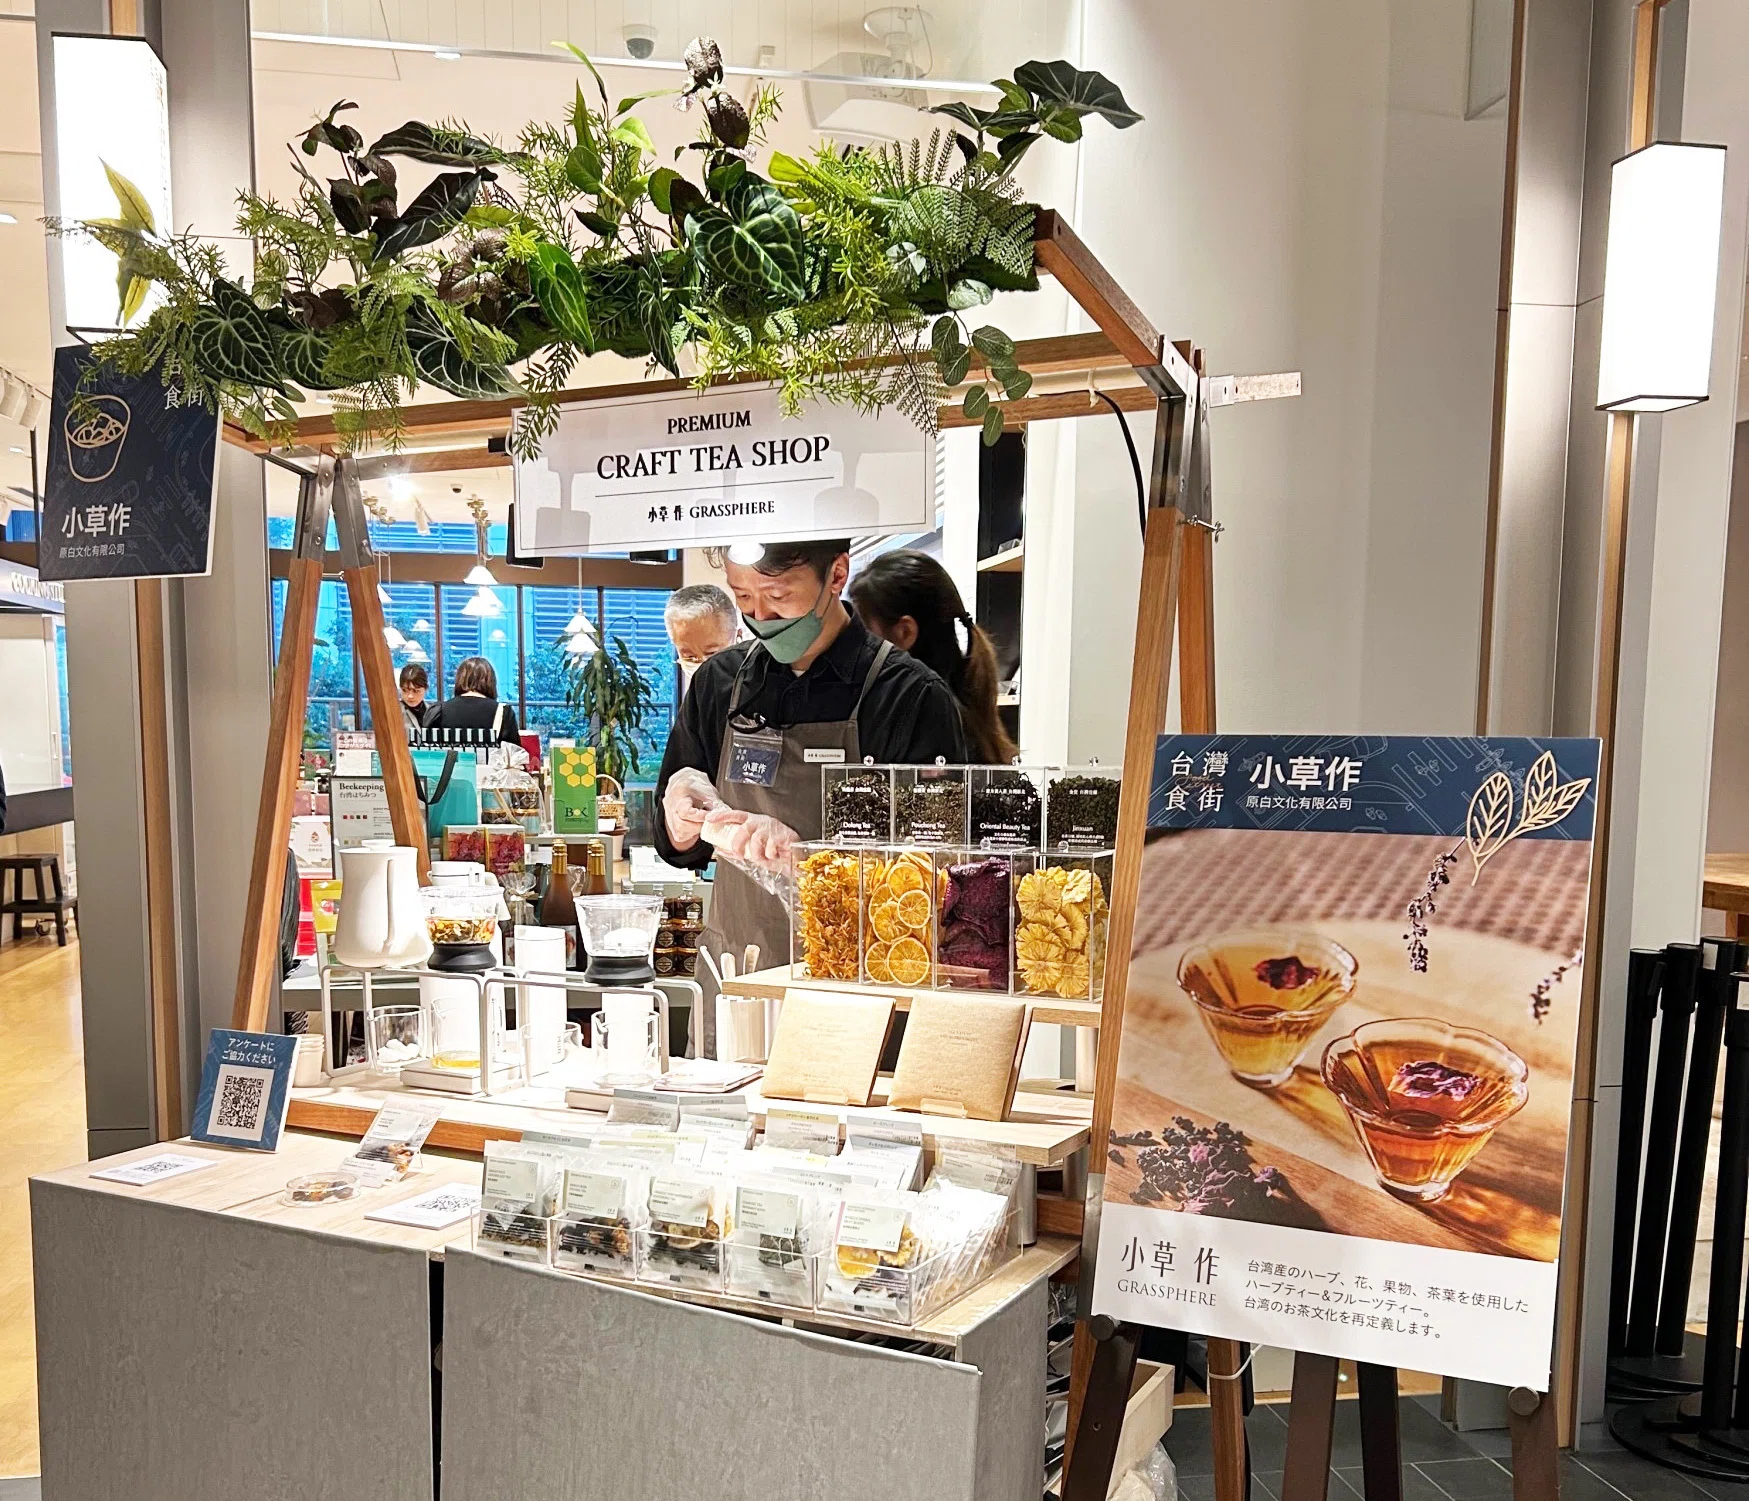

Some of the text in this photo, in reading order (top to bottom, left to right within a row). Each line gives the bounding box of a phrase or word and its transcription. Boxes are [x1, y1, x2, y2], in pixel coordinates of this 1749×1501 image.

[667, 410, 752, 434] PREMIUM
[597, 435, 830, 480] CRAFT TEA SHOP
[61, 503, 132, 538] 小草作
[689, 500, 775, 519] GRASSPHERE
[59, 543, 125, 559] 原白文化有限公司
[1249, 755, 1363, 792] 小草作
[339, 782, 385, 792] Beekeeping
[1164, 784, 1225, 812] 食街
[1245, 795, 1352, 811] 原白文化有限公司
[979, 822, 1002, 830] Oriental
[1002, 823, 1020, 831] Beauty
[222, 1049, 276, 1065] ご協力ください
[228, 1038, 275, 1052] アンケートに
[1121, 1236, 1220, 1285] 小草作
[1117, 1279, 1217, 1307] GRASSPHERE
[1248, 1259, 1529, 1314] 台湾産のハーブ、花、果物、茶葉を使用した
[1244, 1296, 1441, 1339] 台湾のお茶文化を再定義します。
